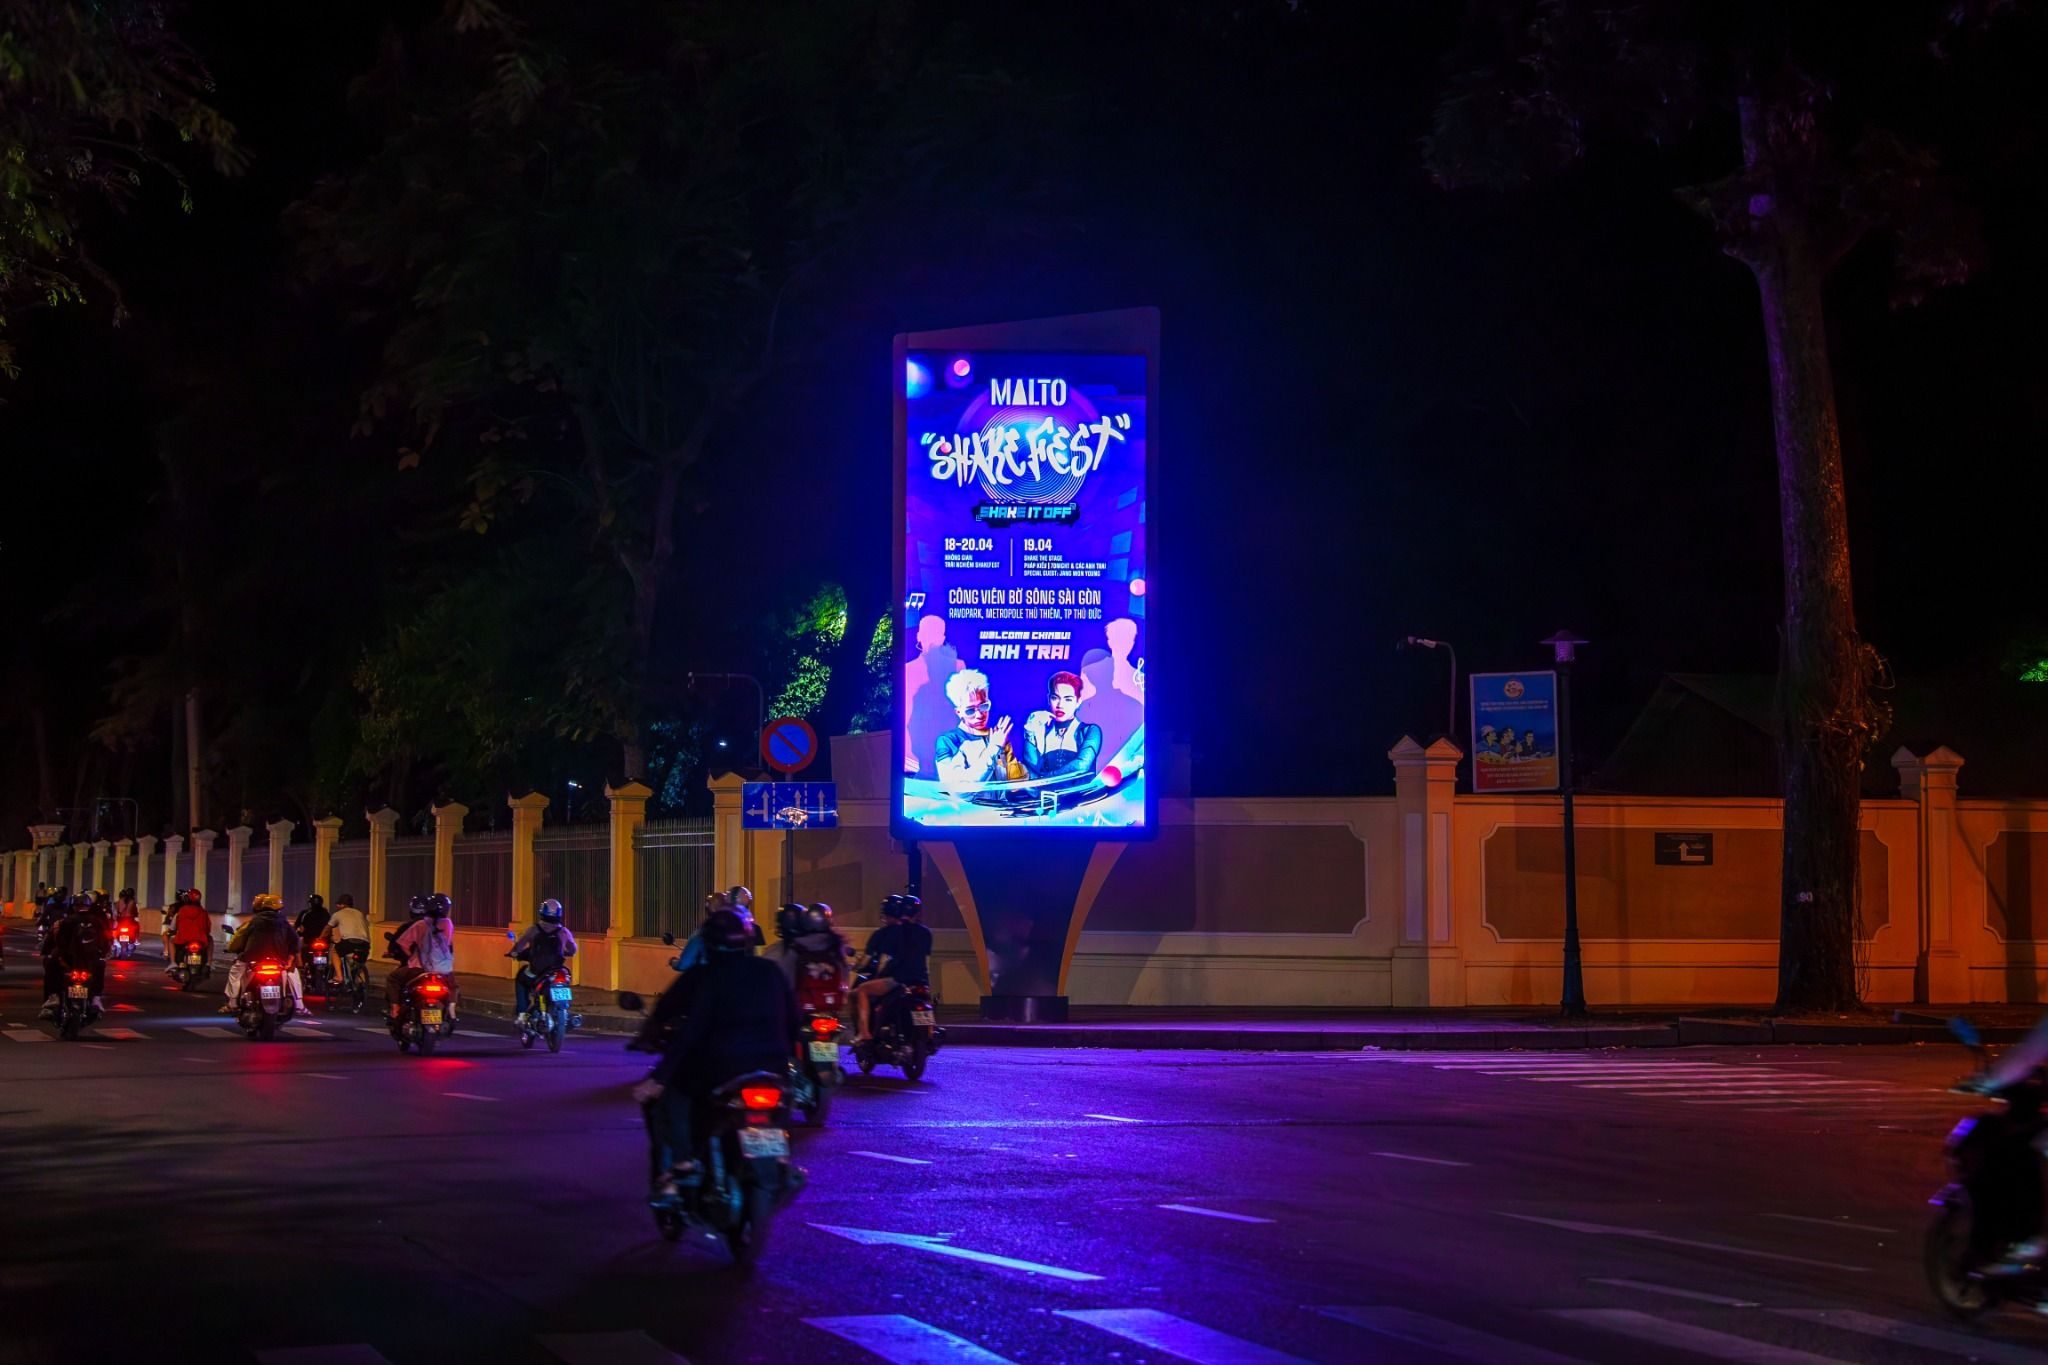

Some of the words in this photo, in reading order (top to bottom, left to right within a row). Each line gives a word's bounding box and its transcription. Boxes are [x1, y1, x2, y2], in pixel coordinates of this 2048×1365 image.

[991, 378, 1067, 407] MALTO
[980, 506, 1026, 518] SHAKE
[1028, 506, 1042, 518] IT
[1043, 506, 1072, 518] OFF
[944, 538, 993, 551] 18-20.04
[1024, 538, 1052, 551] 19.04
[949, 587, 979, 605] CÔNG
[981, 587, 1005, 605] VIÊN
[1008, 587, 1024, 605] BỜ
[1026, 587, 1055, 605] SÔNG
[1058, 587, 1075, 605] SÀI
[1078, 587, 1101, 605] GÒN
[986, 608, 1024, 620] METROPOLE
[1026, 608, 1038, 620] THỦ
[1040, 608, 1062, 620] THIÊM,
[1064, 608, 1072, 620] TP
[980, 631, 1030, 640] WELCOME
[980, 644, 1020, 659] ANH
[1025, 644, 1070, 659] TRAI
